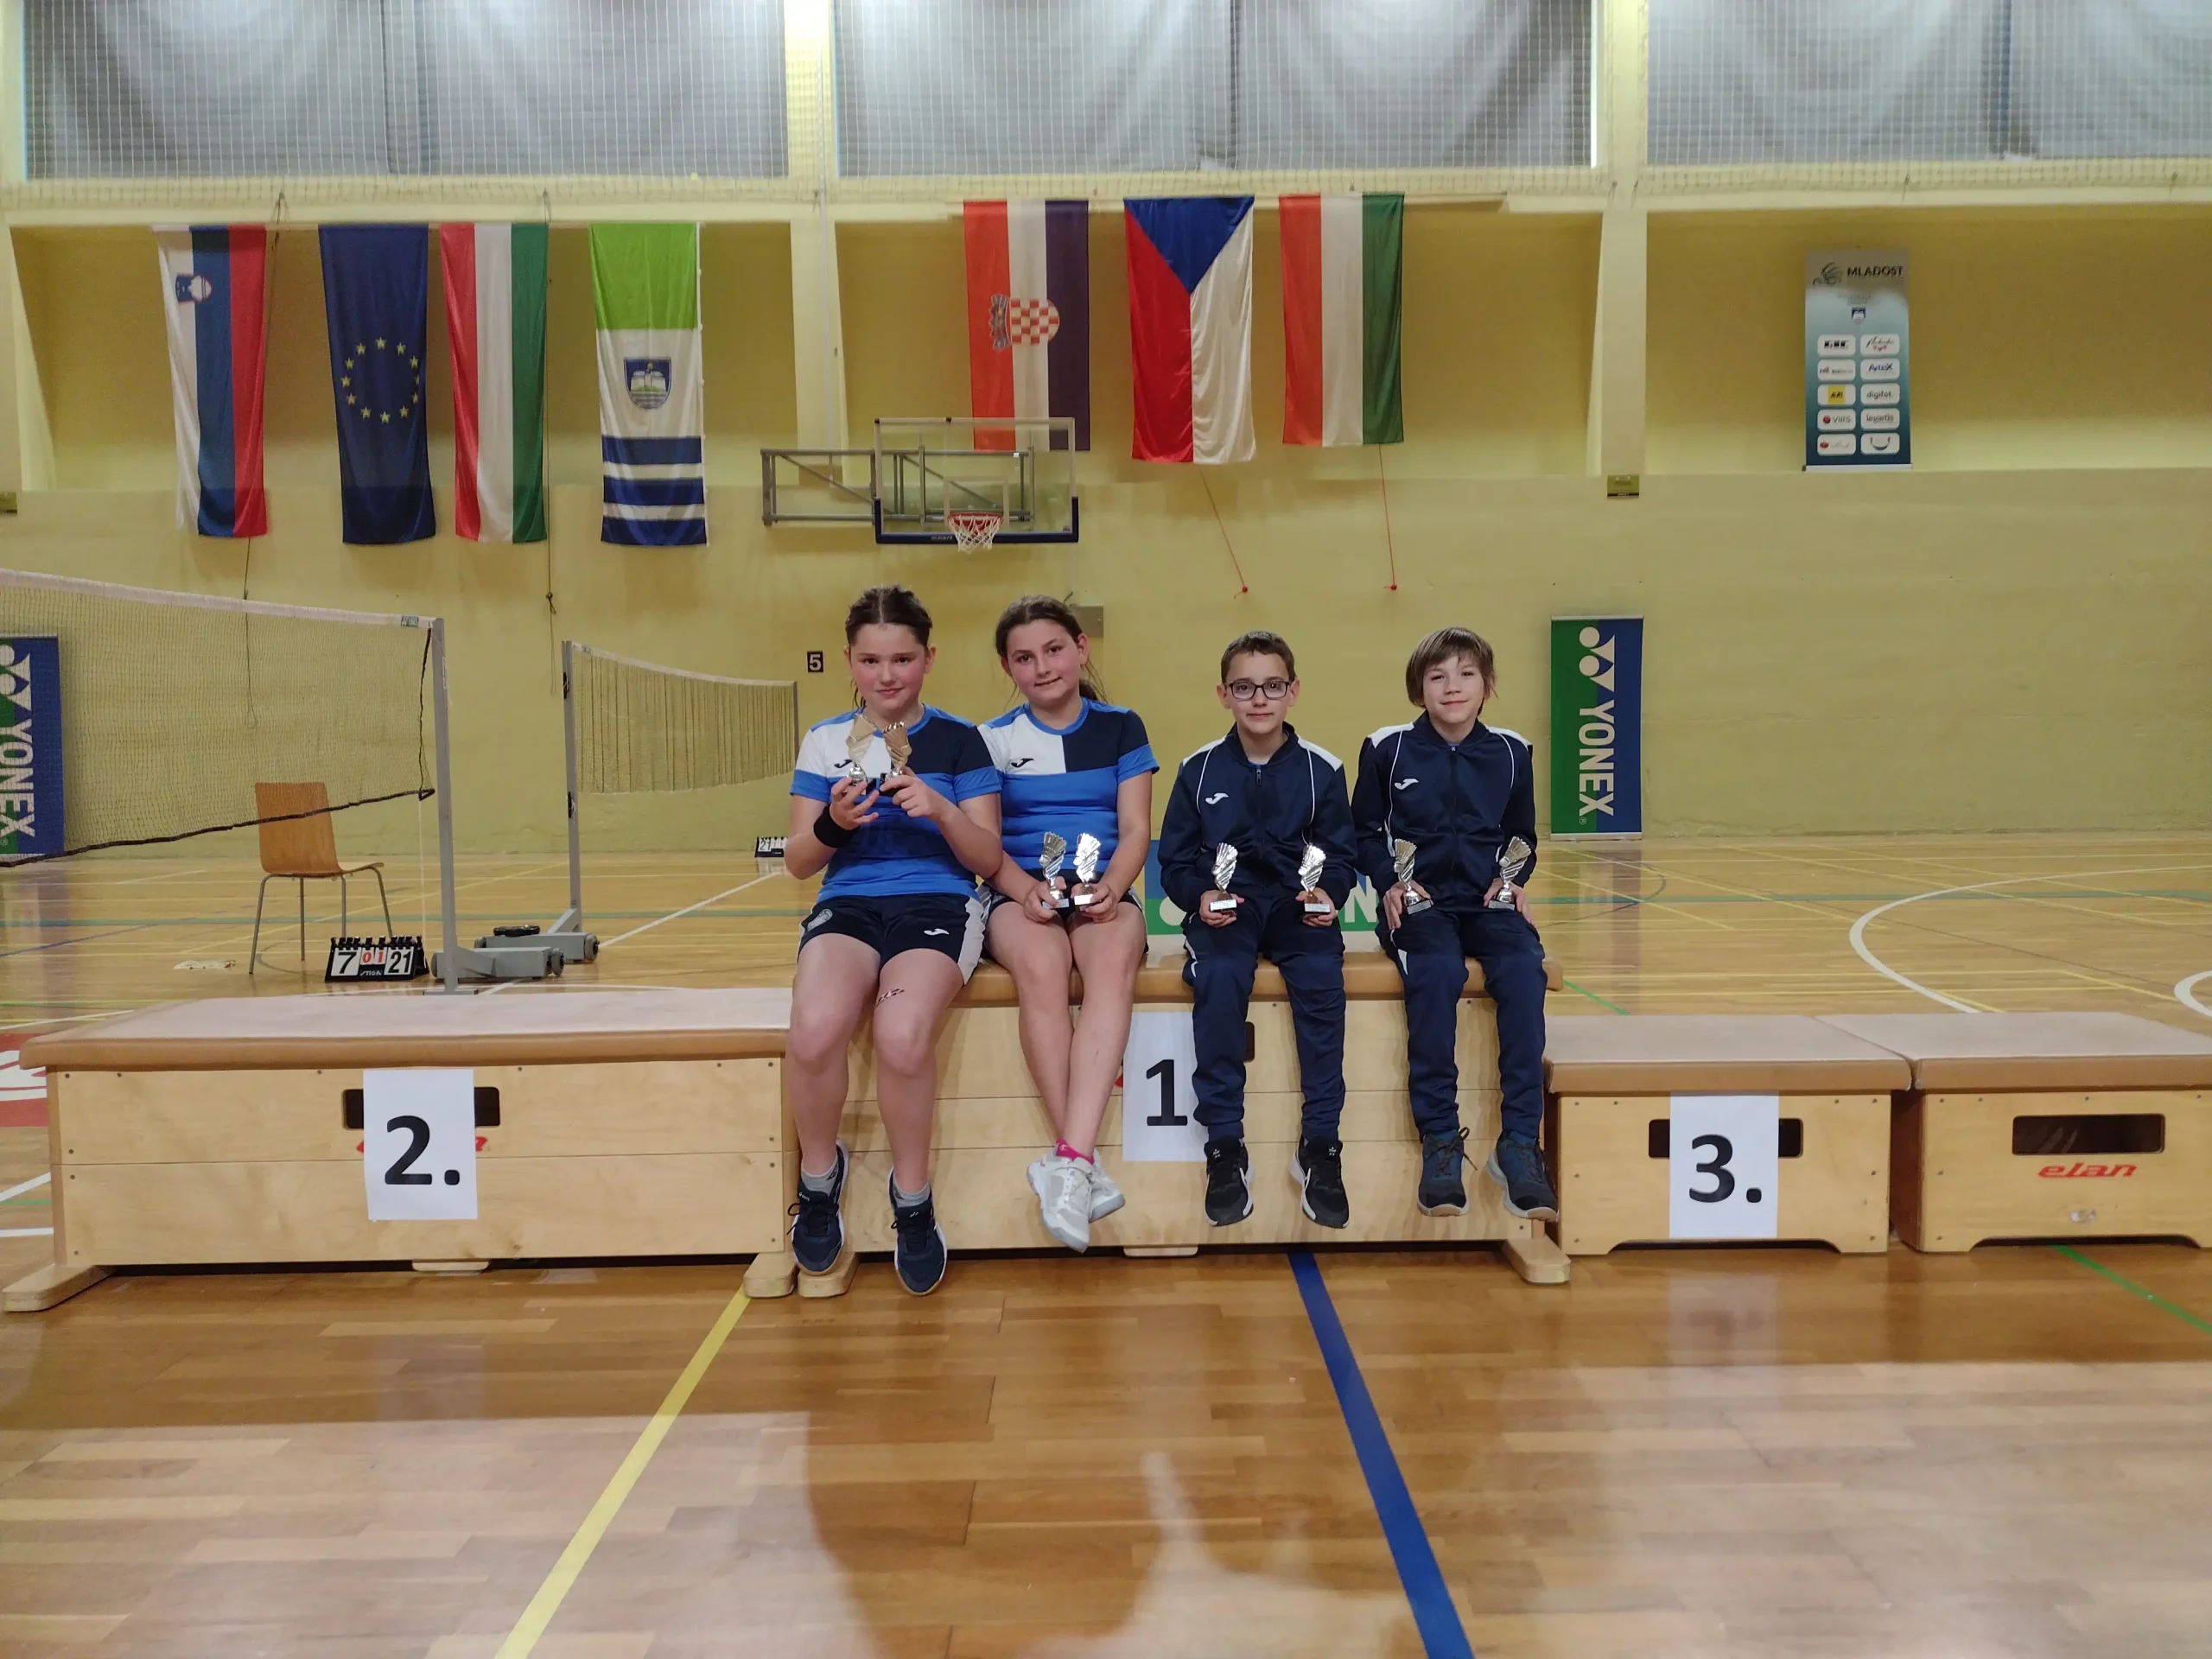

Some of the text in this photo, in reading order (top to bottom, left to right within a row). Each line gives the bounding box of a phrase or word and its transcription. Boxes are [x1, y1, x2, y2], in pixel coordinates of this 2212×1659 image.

[1847, 265, 1904, 276] MLADOST
[809, 653, 822, 671] 5
[0, 718, 35, 837] YONEX
[1579, 699, 1616, 817] YONEX
[338, 950, 411, 975] 7 0 1 21
[385, 1115, 461, 1185] 2.
[1689, 1135, 1762, 1203] 3.
[2038, 1161, 2138, 1178] elan
